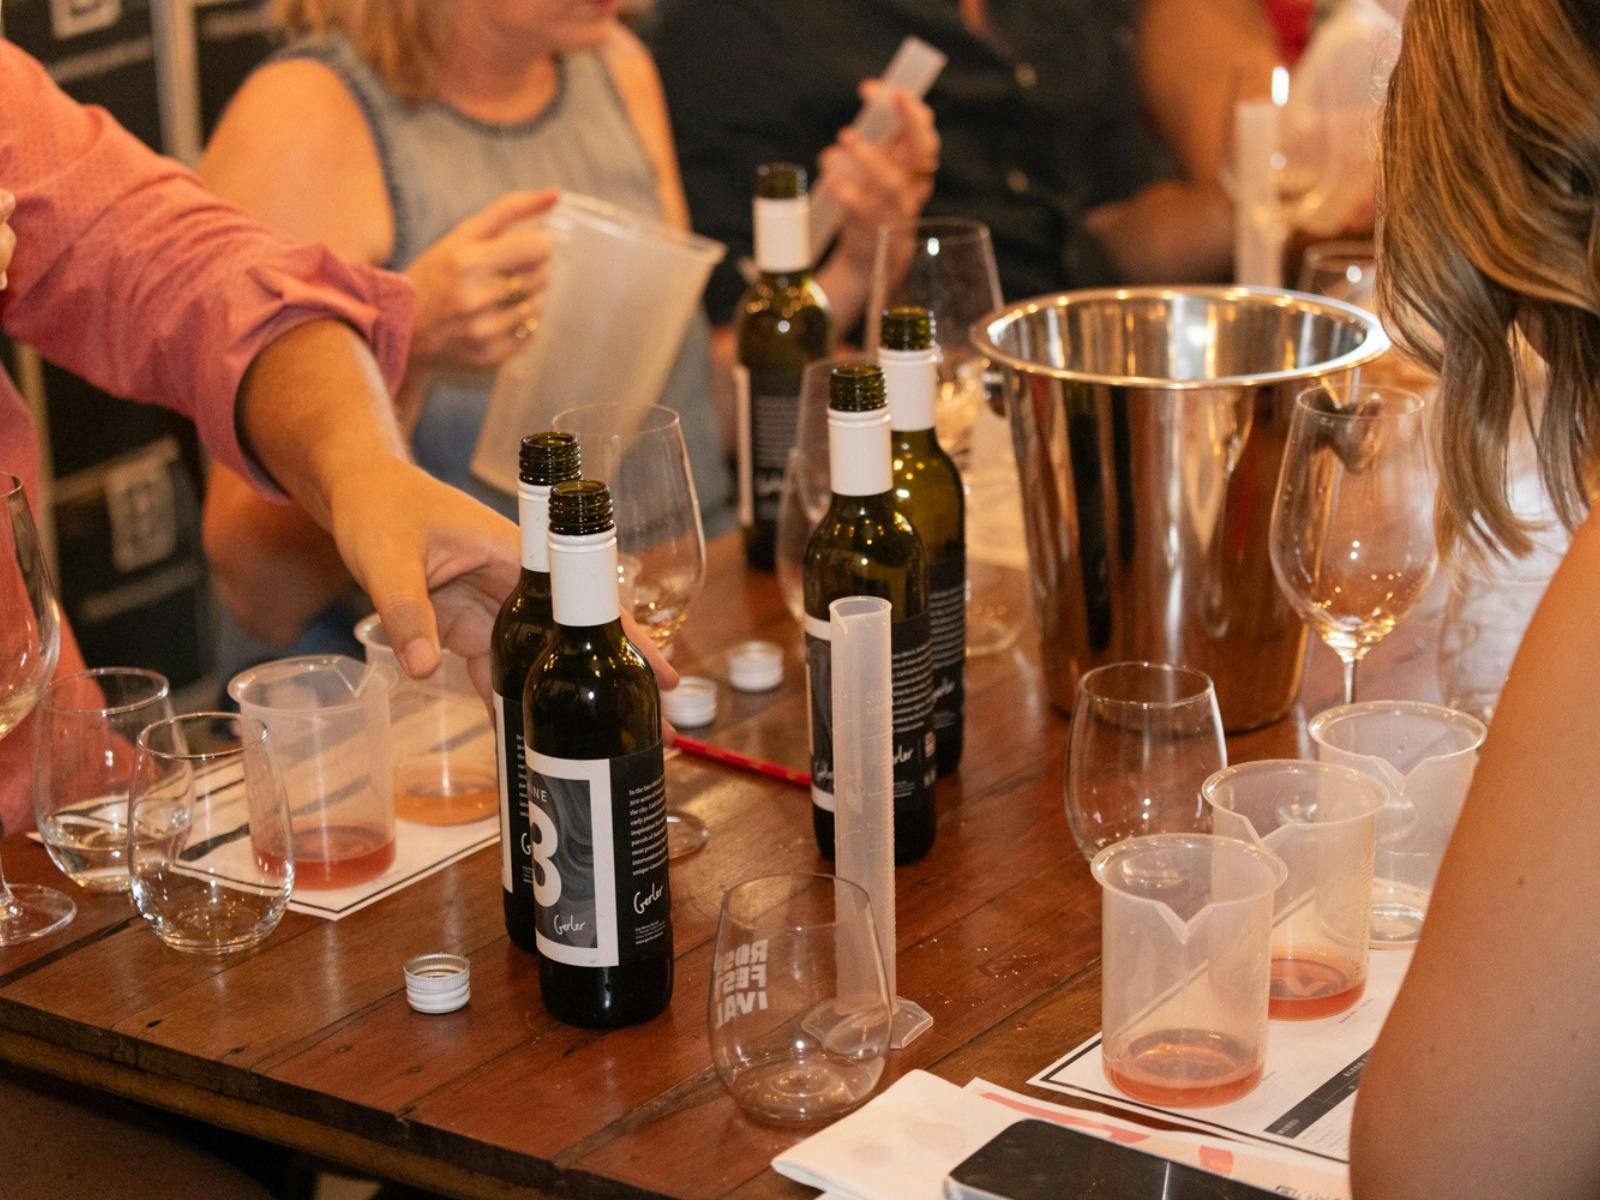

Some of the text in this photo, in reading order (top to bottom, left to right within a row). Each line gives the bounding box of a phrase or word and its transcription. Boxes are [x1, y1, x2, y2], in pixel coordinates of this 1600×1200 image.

[532, 786, 548, 802] NE
[633, 882, 664, 914] Gerler
[553, 914, 587, 936] Gerler
